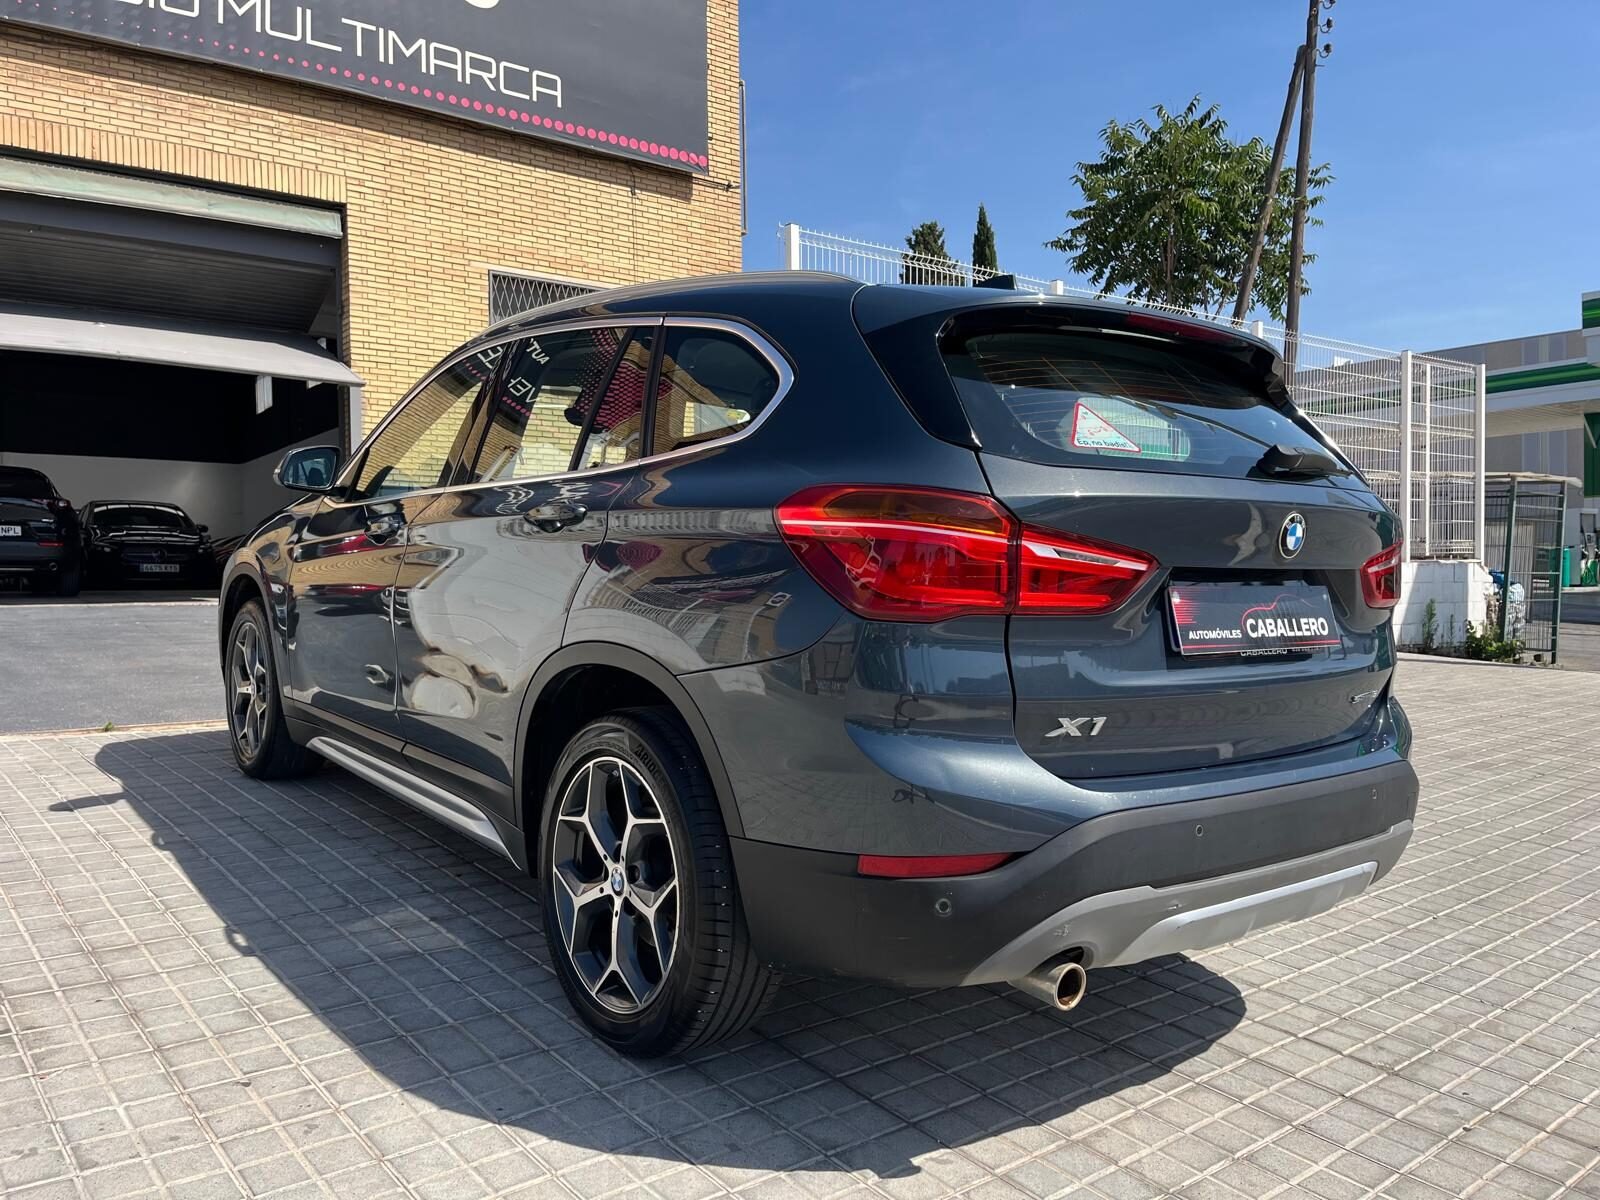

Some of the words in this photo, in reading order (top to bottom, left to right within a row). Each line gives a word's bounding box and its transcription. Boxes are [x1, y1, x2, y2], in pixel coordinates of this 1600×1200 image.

[218, 0, 562, 108] MULTIMARCA
[1, 526, 20, 535] NPL
[1189, 627, 1242, 640] AUTOMÓVILES
[1246, 617, 1329, 638] CABALLERO
[1044, 716, 1108, 737] X1
